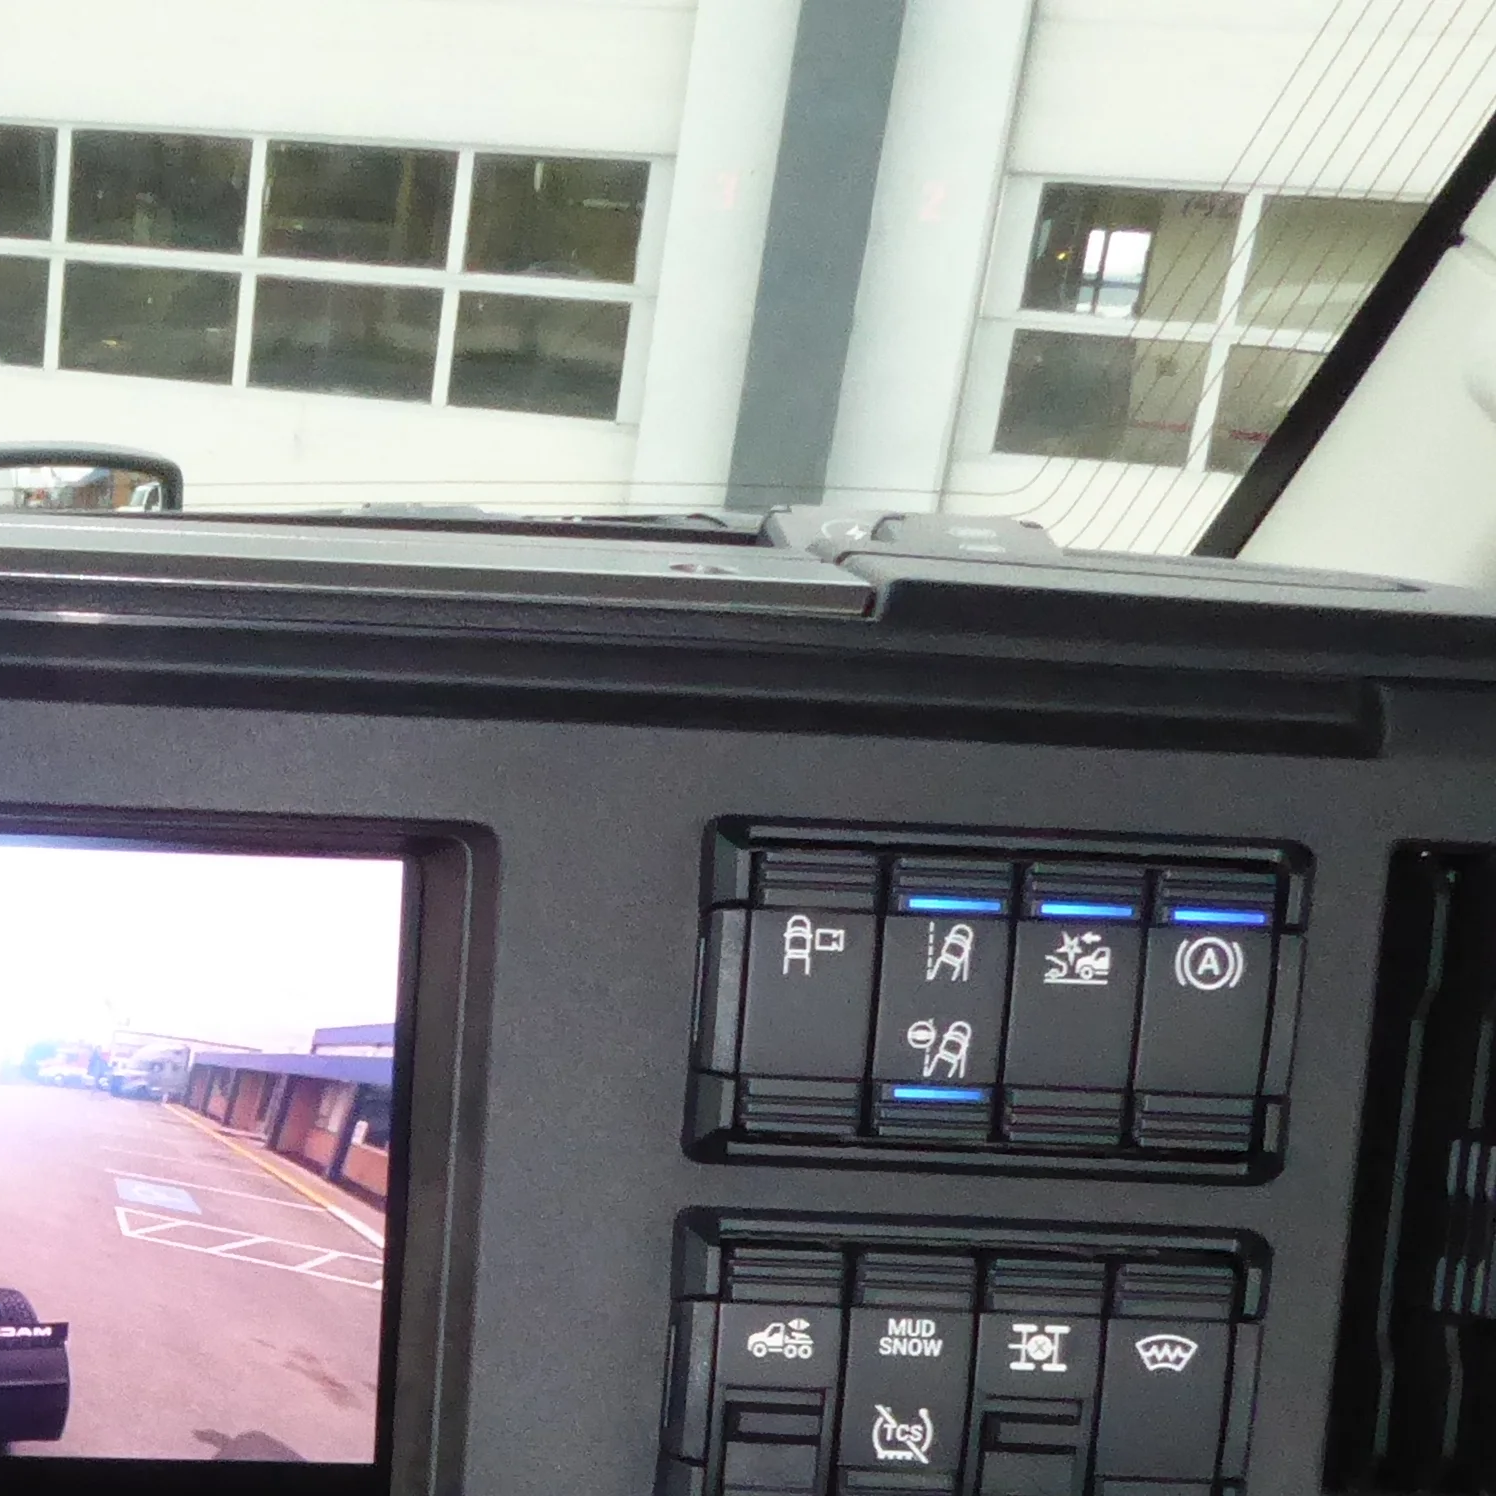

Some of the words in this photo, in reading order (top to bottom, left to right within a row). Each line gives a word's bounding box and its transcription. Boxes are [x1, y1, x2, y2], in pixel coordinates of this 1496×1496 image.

[887, 1318, 936, 1338] MUD
[878, 1337, 943, 1358] SNOW
[883, 1419, 923, 1443] TCS
